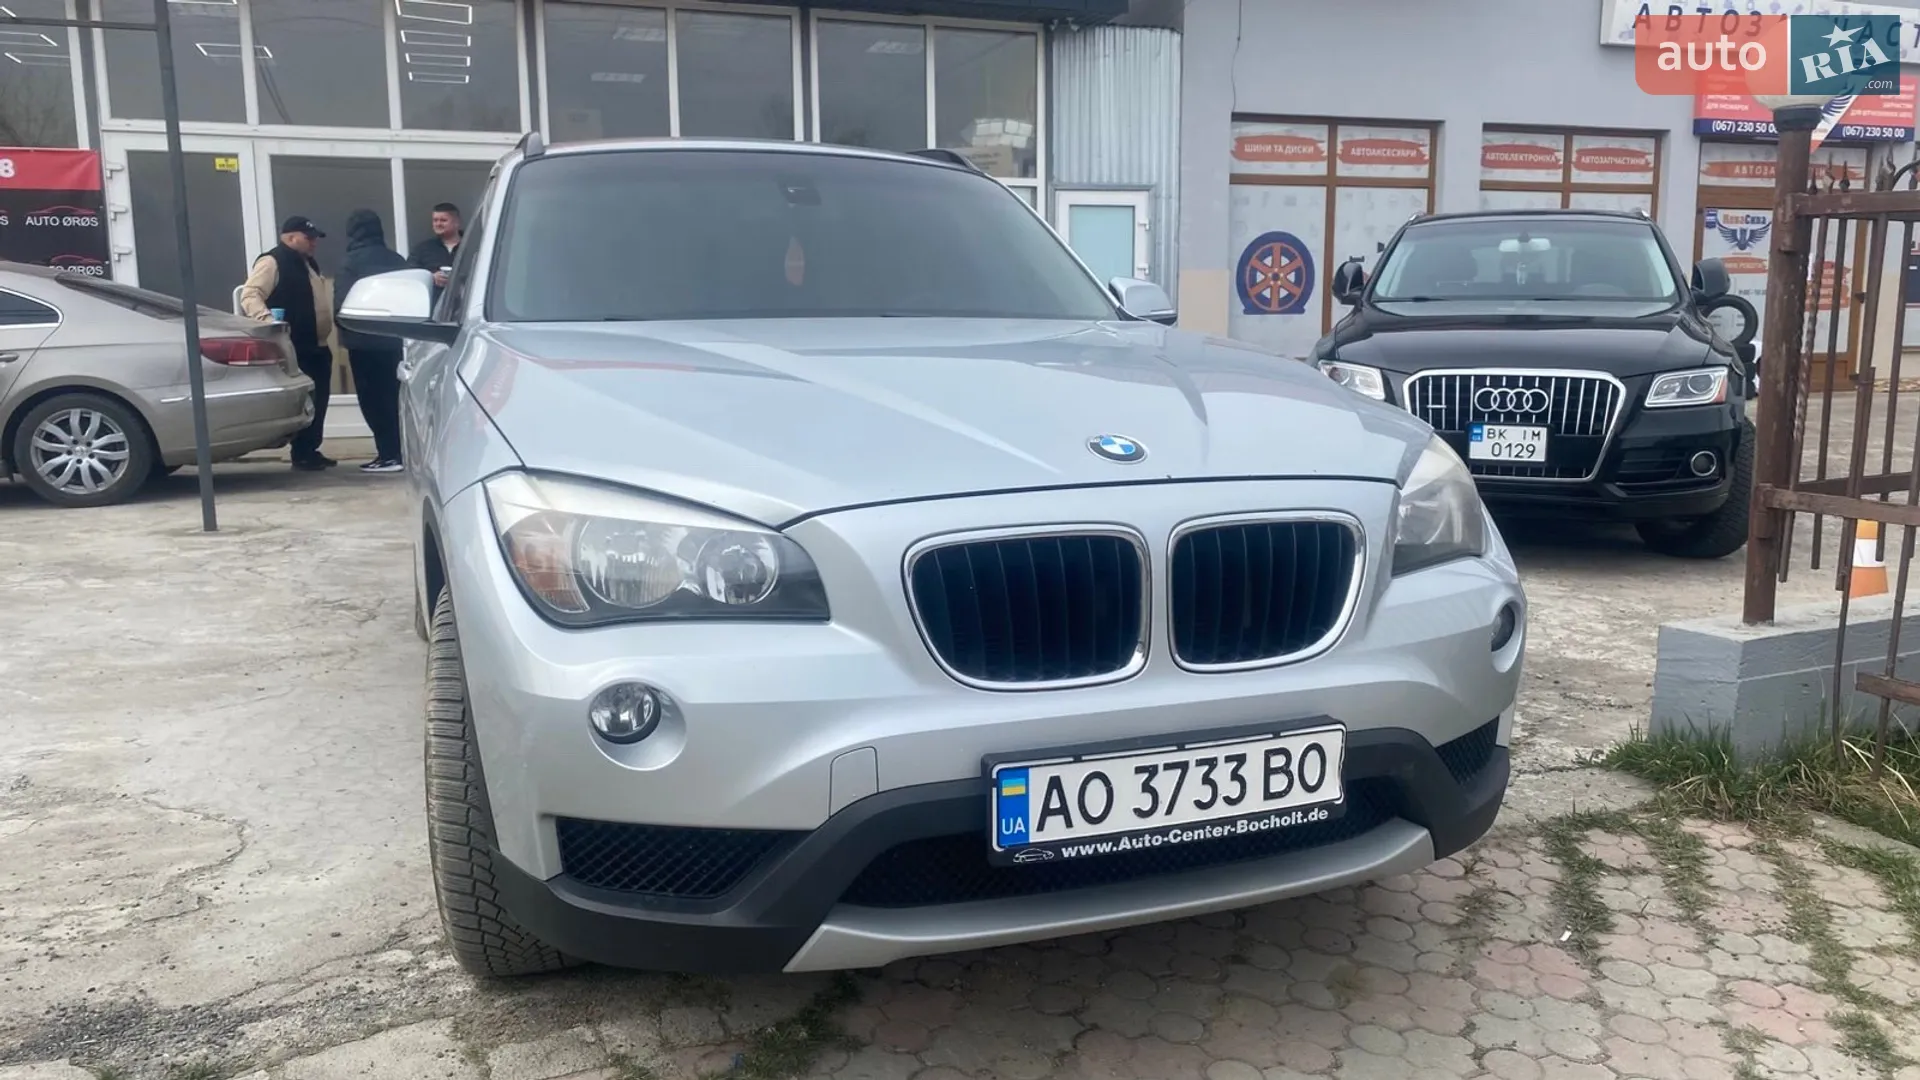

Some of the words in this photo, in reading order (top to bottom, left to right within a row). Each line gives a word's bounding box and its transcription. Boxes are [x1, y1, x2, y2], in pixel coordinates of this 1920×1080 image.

[1712, 120, 1735, 133] (067)
[1737, 121, 1754, 132] 230
[1755, 122, 1767, 133] 50
[1842, 125, 1864, 138] (067)
[1865, 126, 1881, 137] 230
[1882, 127, 1893, 137] 50
[1894, 127, 1905, 138] 00
[1244, 143, 1272, 153] ШИНИ
[1273, 144, 1284, 153] ТА
[1285, 145, 1314, 155] ДИСКИ
[25, 216, 60, 226] AUTO
[62, 216, 99, 227] ØRØS
[1486, 428, 1507, 440] BK
[1522, 429, 1541, 441] IM
[1491, 442, 1536, 459] 0129
[1036, 770, 1114, 833] AO
[1132, 752, 1248, 820] 3733
[1262, 741, 1327, 802] BO
[1001, 817, 1026, 835] UA
[1061, 808, 1329, 858] www.Auto-Center-Bocholt.de
